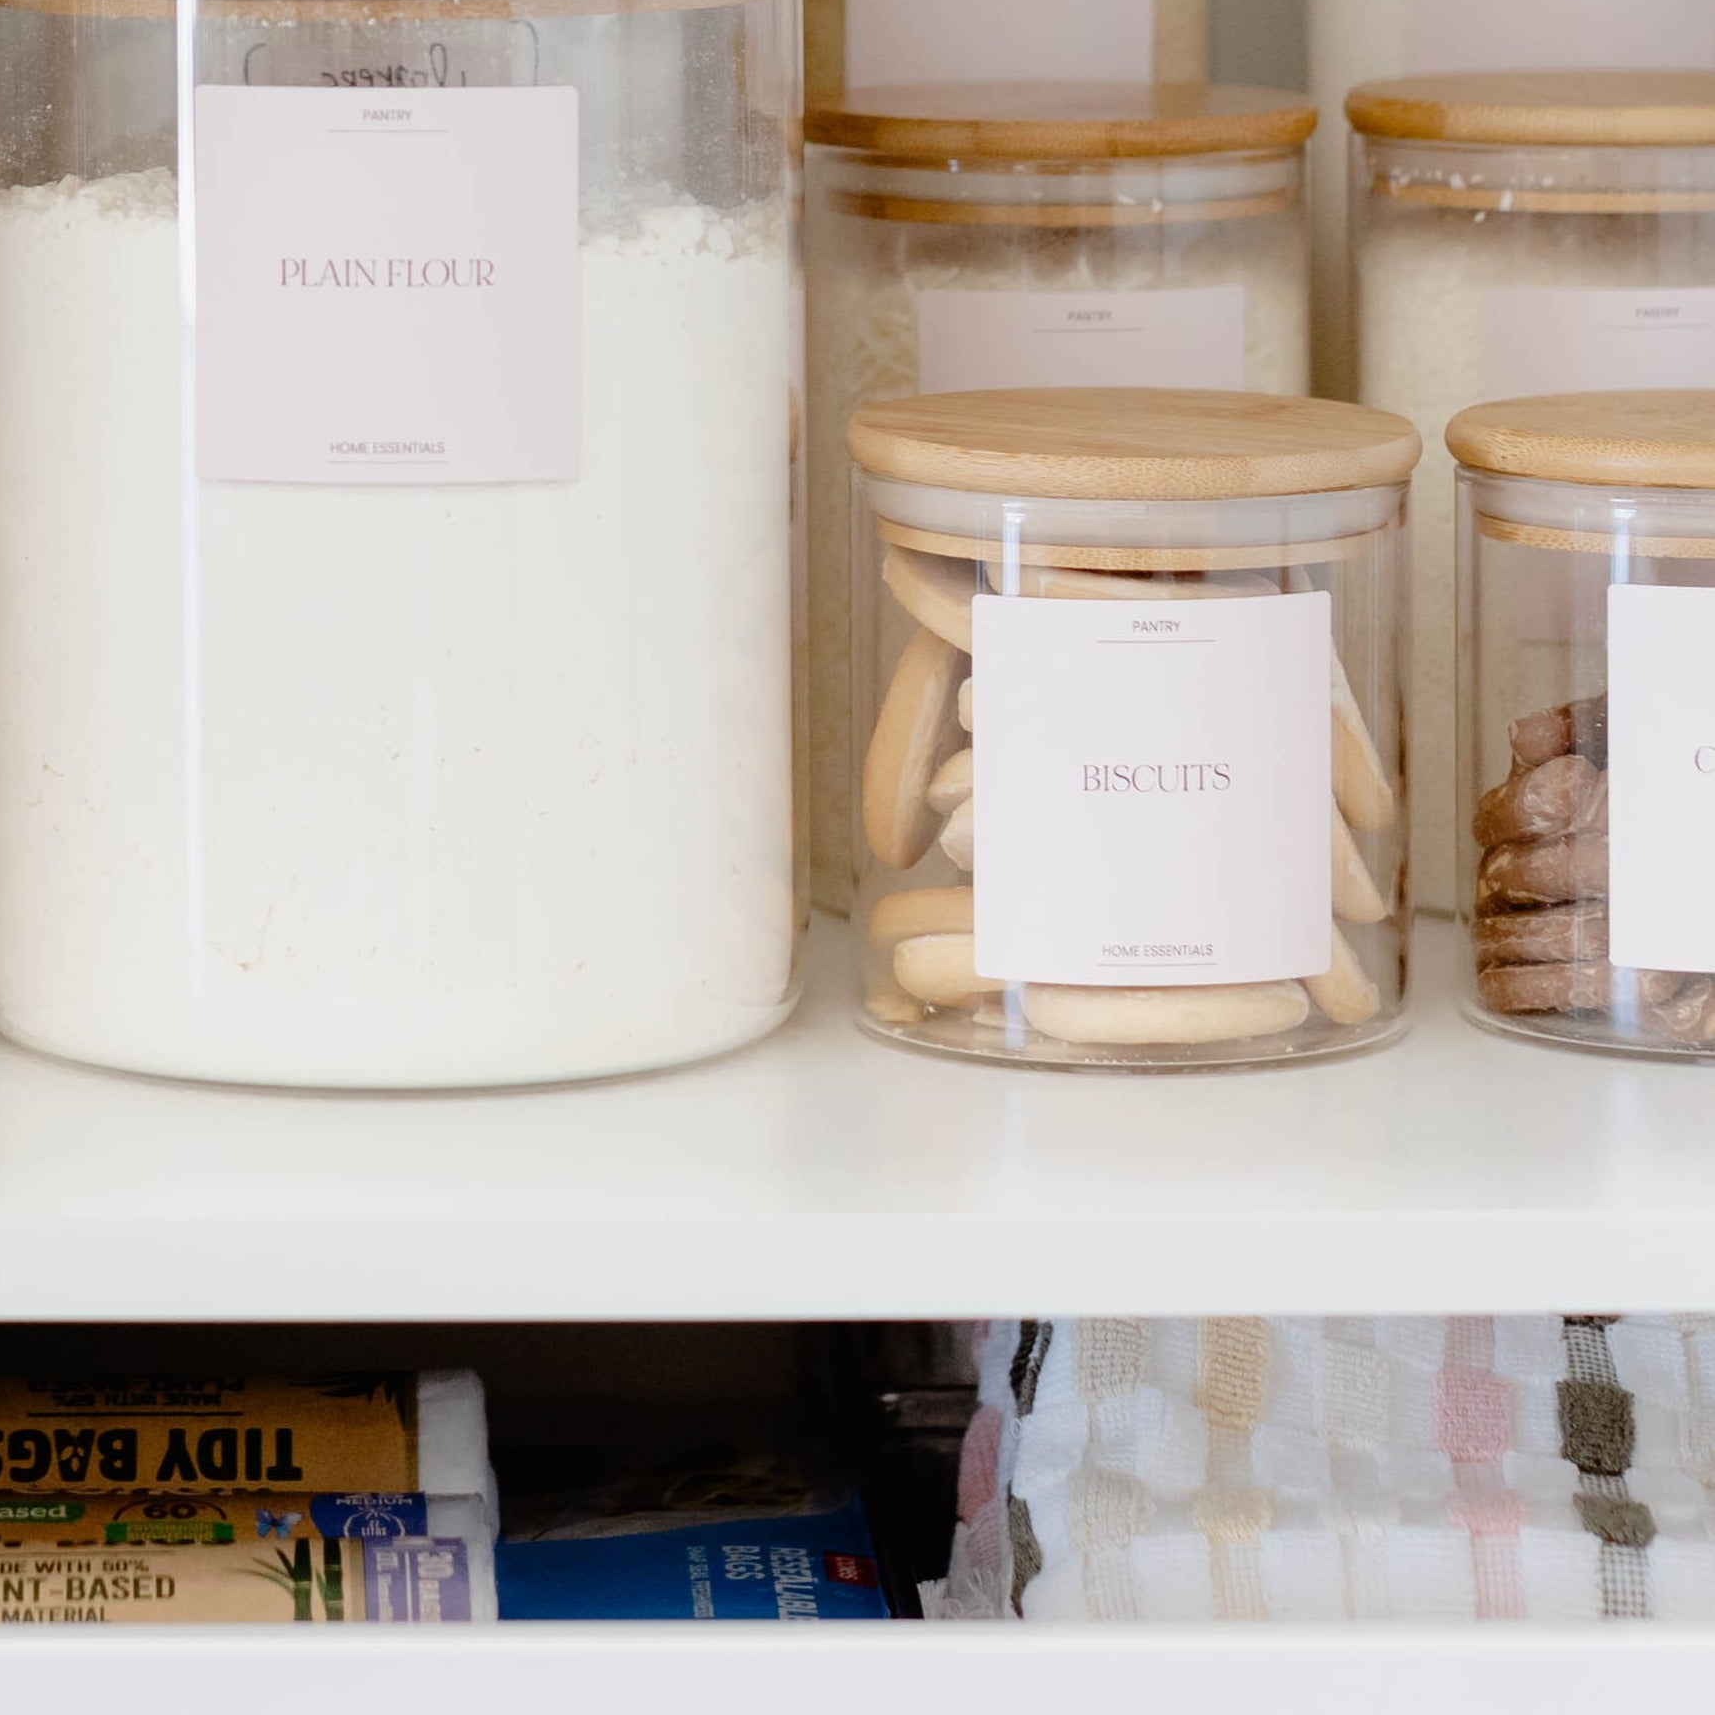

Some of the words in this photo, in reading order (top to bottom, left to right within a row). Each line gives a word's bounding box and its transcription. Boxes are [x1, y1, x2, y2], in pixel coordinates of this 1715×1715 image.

[362, 109, 414, 122] PANTRY
[281, 258, 377, 287] PLAIN
[387, 258, 495, 287] FLOUR
[329, 441, 368, 454] HOME
[371, 441, 446, 454] ESSENTIALS
[1132, 620, 1182, 633] PANTRY
[1082, 762, 1232, 793] BISCUITS
[1102, 945, 1140, 958] HOME
[1143, 944, 1214, 958] ESSENTIALS
[156, 1428, 304, 1482] TIDY
[34, 1559, 91, 1574] WITH
[721, 1545, 766, 1581] BAGS
[1, 1606, 110, 1623] MATERIAL
